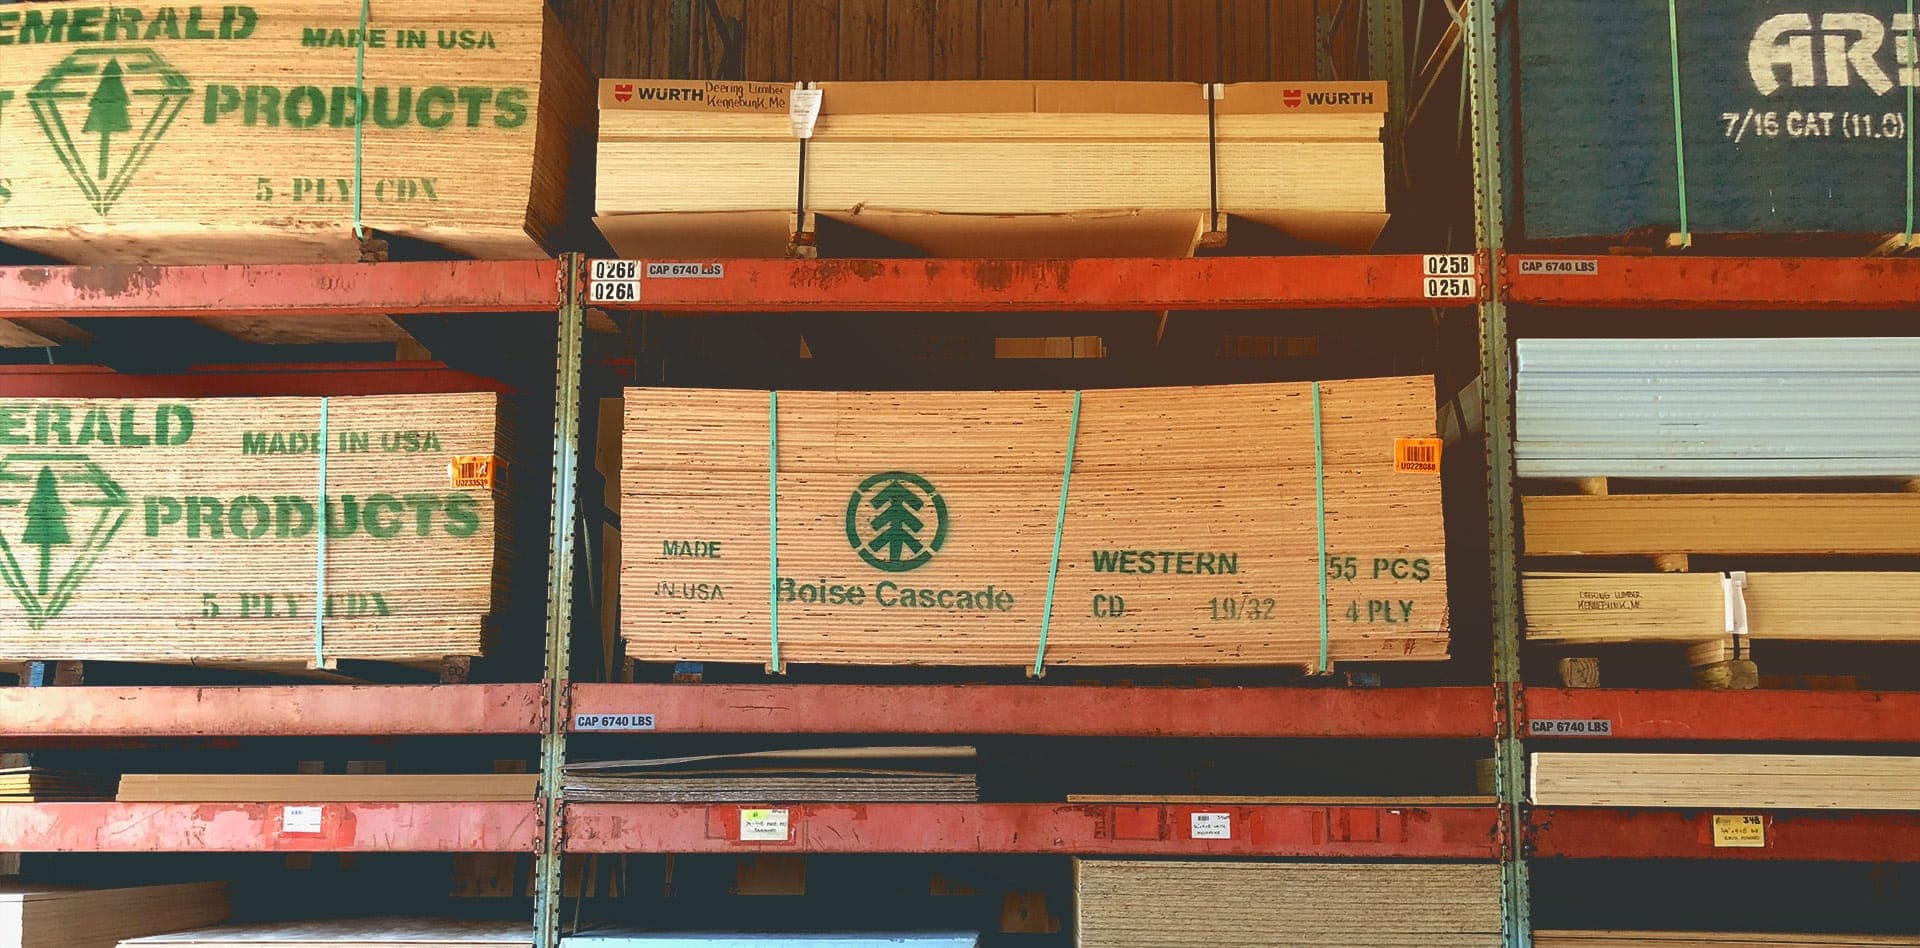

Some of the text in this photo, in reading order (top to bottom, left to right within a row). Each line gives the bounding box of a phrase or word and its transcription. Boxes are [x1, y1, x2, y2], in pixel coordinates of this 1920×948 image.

[302, 28, 496, 49] MADE IN USA
[638, 88, 704, 101] WÜRTH
[705, 81, 784, 97] Deering Lumber
[1307, 92, 1373, 105] WÜRTH
[204, 84, 528, 130] PRODUCTS
[769, 98, 786, 109] Me
[1722, 108, 1905, 143] 7/16 CAT (11.0)
[256, 177, 438, 204] 5 PLY CDX
[596, 262, 635, 279] Q26B
[649, 264, 721, 275] CAP 6740 LBS
[1429, 256, 1469, 273] Q25B
[1522, 261, 1595, 272] CAP 6740 LBS
[595, 283, 634, 300] Q26A
[1429, 279, 1470, 296] Q25A
[338, 431, 369, 452] IN
[381, 431, 441, 453] USA
[144, 493, 482, 538] PRODUCTS
[663, 540, 721, 559] MADE
[1092, 550, 1238, 575] WESTERN
[1329, 556, 1431, 582] 55 PCS
[656, 581, 724, 600] IN USA
[774, 577, 1015, 611] Boise Cascade
[202, 592, 219, 617] 5
[240, 592, 298, 617] PLY
[1093, 594, 1125, 618] CD
[1208, 597, 1276, 621] 19/32
[1344, 600, 1414, 624] 4 PLY
[578, 716, 652, 726] CAP 6740 LBS
[1532, 721, 1609, 732] CAP 6740 LBS
